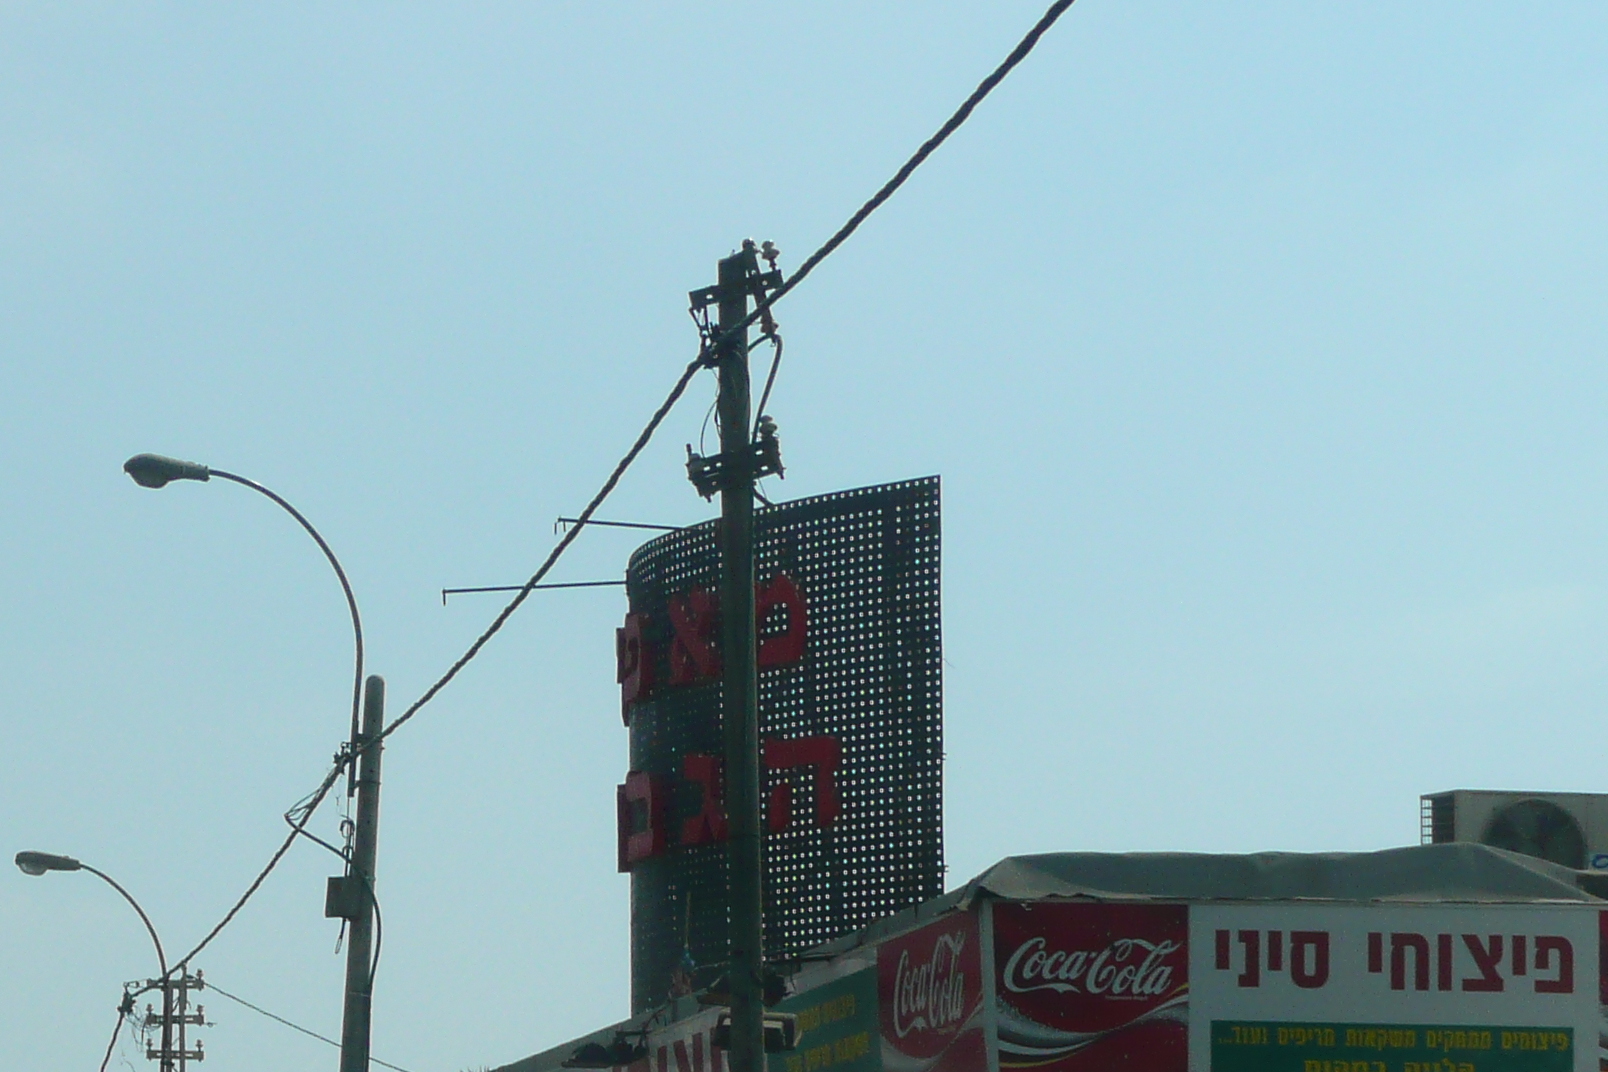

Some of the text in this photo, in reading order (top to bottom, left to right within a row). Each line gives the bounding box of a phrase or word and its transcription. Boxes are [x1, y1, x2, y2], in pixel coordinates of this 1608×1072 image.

[1003, 936, 1183, 996] Coca-Cola
[1214, 928, 1575, 994] פיצוחי סיני
